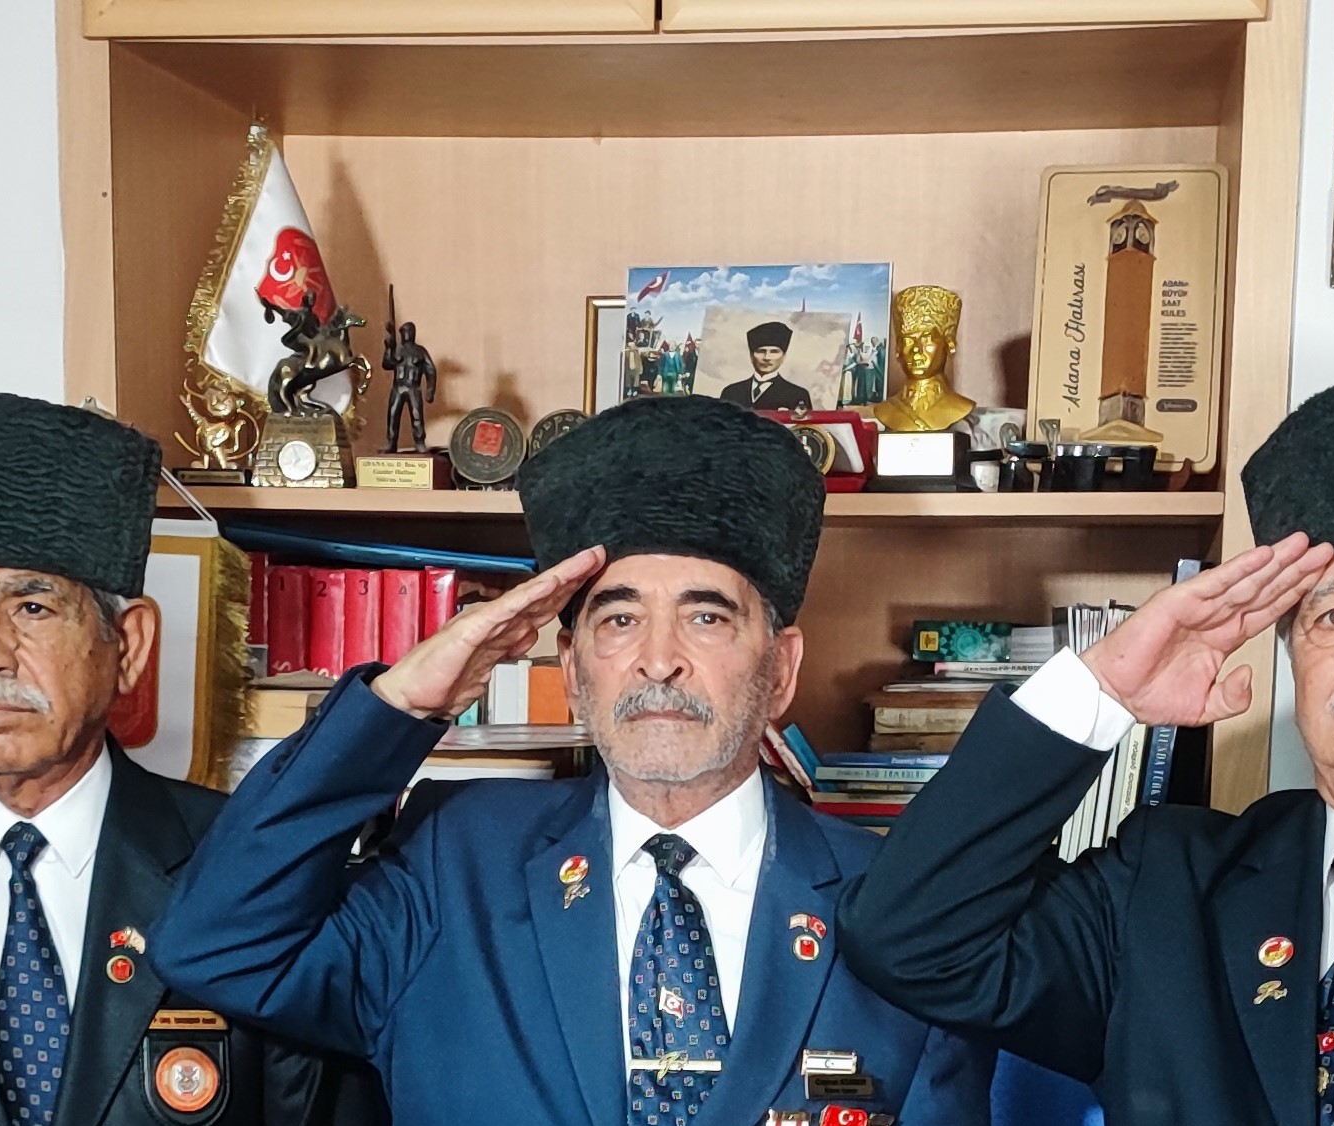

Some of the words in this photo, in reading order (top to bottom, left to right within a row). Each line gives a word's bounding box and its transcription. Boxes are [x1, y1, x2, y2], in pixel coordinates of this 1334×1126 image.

[1062, 347, 1081, 411] Adana
[317, 580, 328, 598] 2
[358, 579, 369, 596] 3
